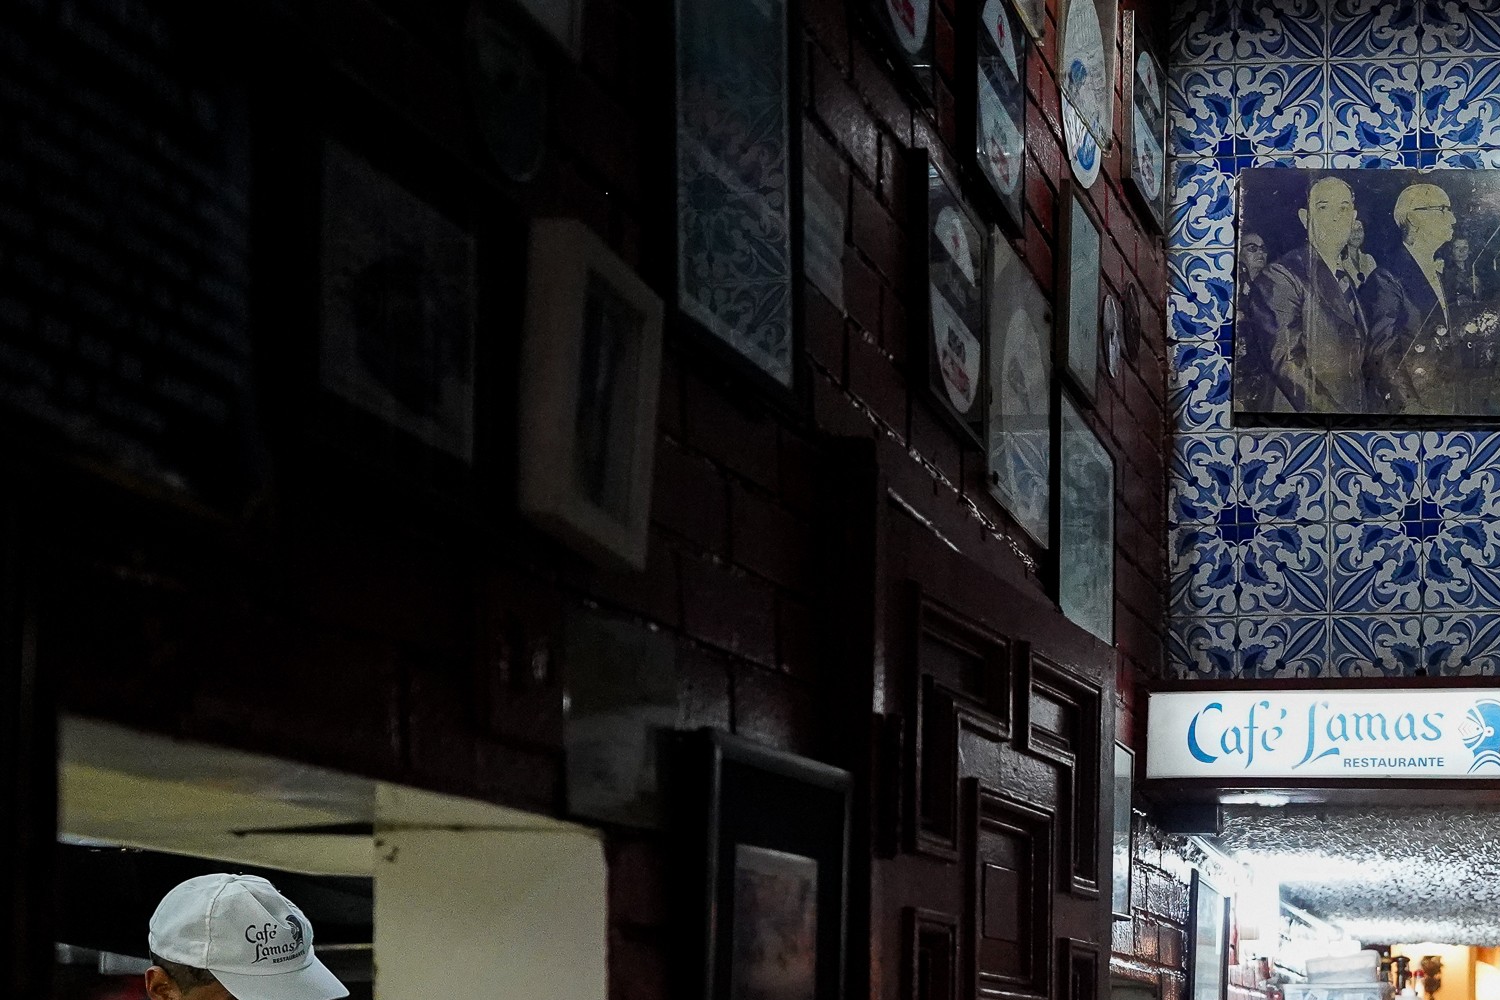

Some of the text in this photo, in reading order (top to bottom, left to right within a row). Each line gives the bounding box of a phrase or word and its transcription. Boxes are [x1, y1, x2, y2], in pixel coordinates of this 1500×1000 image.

[1187, 700, 1445, 770] Café Lamas
[1343, 757, 1445, 768] RESTAURANTE
[245, 923, 278, 944] Café
[251, 943, 295, 964] Lamas
